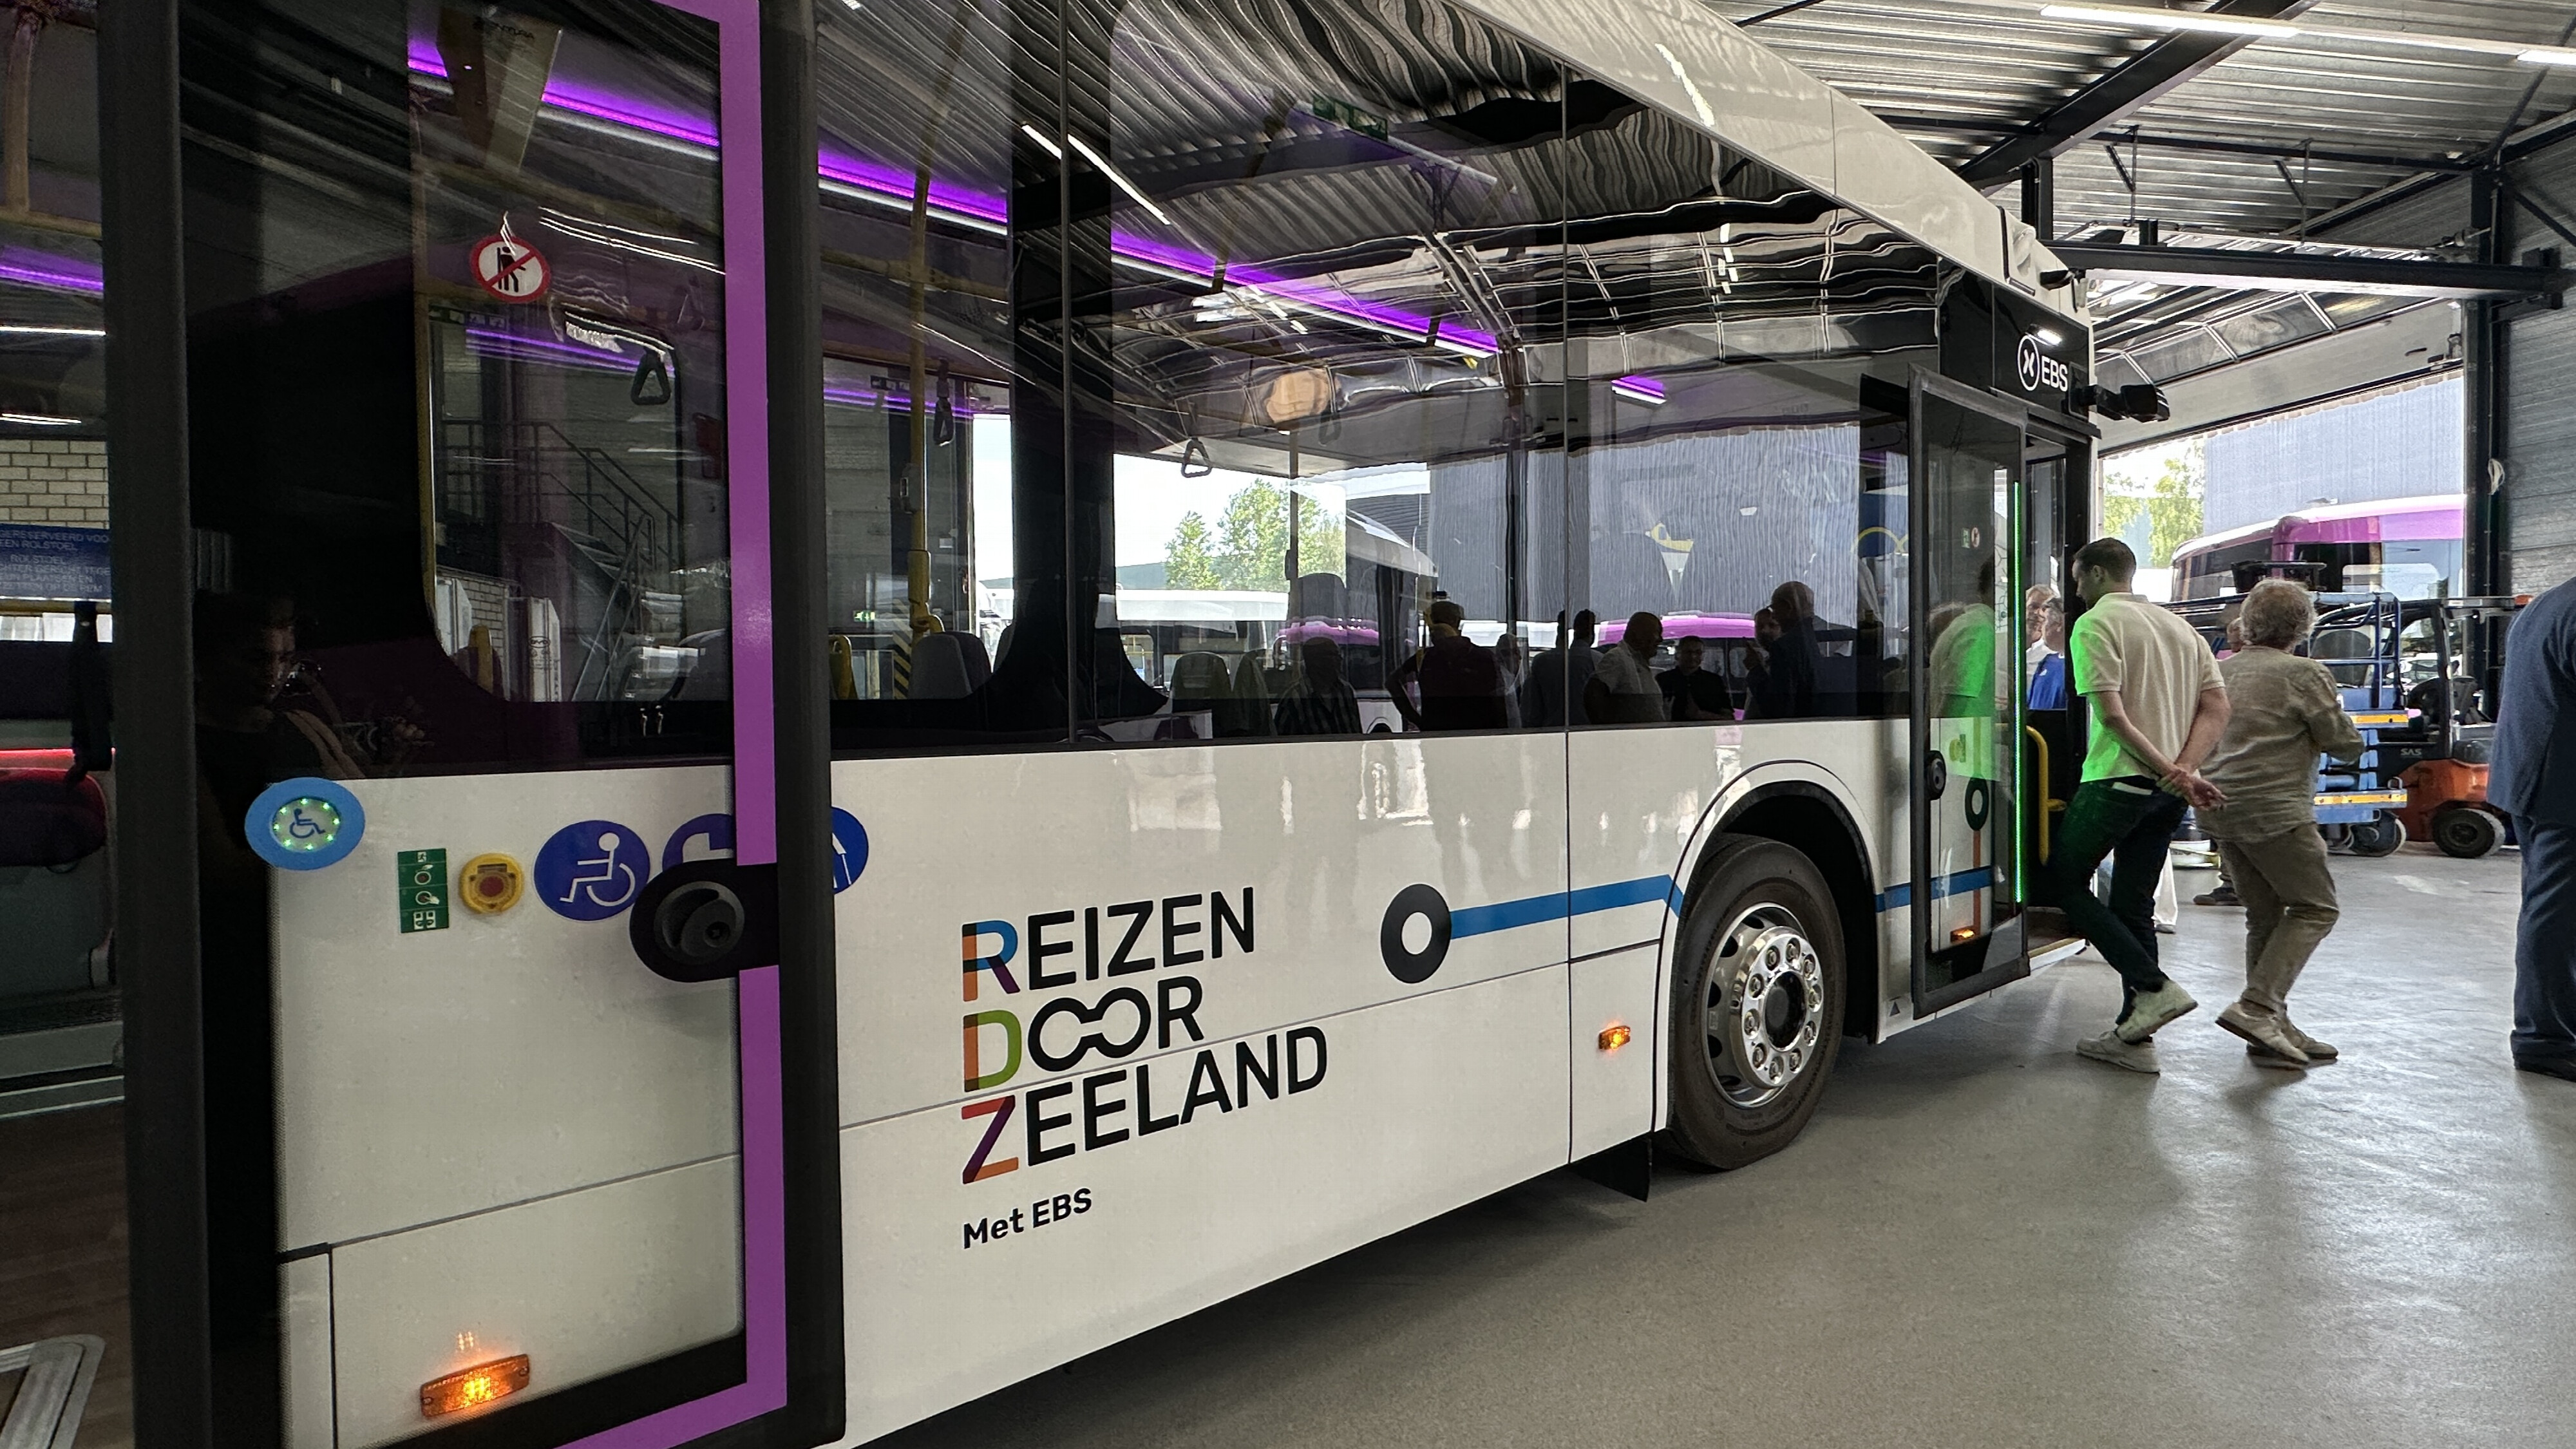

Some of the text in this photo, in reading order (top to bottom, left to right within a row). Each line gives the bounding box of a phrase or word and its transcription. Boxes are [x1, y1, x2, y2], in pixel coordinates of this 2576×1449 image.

[2041, 355, 2069, 392] EBS
[86, 534, 110, 544] VOO
[961, 886, 1254, 1002] REIZEN
[963, 975, 1204, 1092] DOOR
[961, 1026, 1327, 1184] ZEELAND
[963, 1188, 1092, 1249] Met EBS
